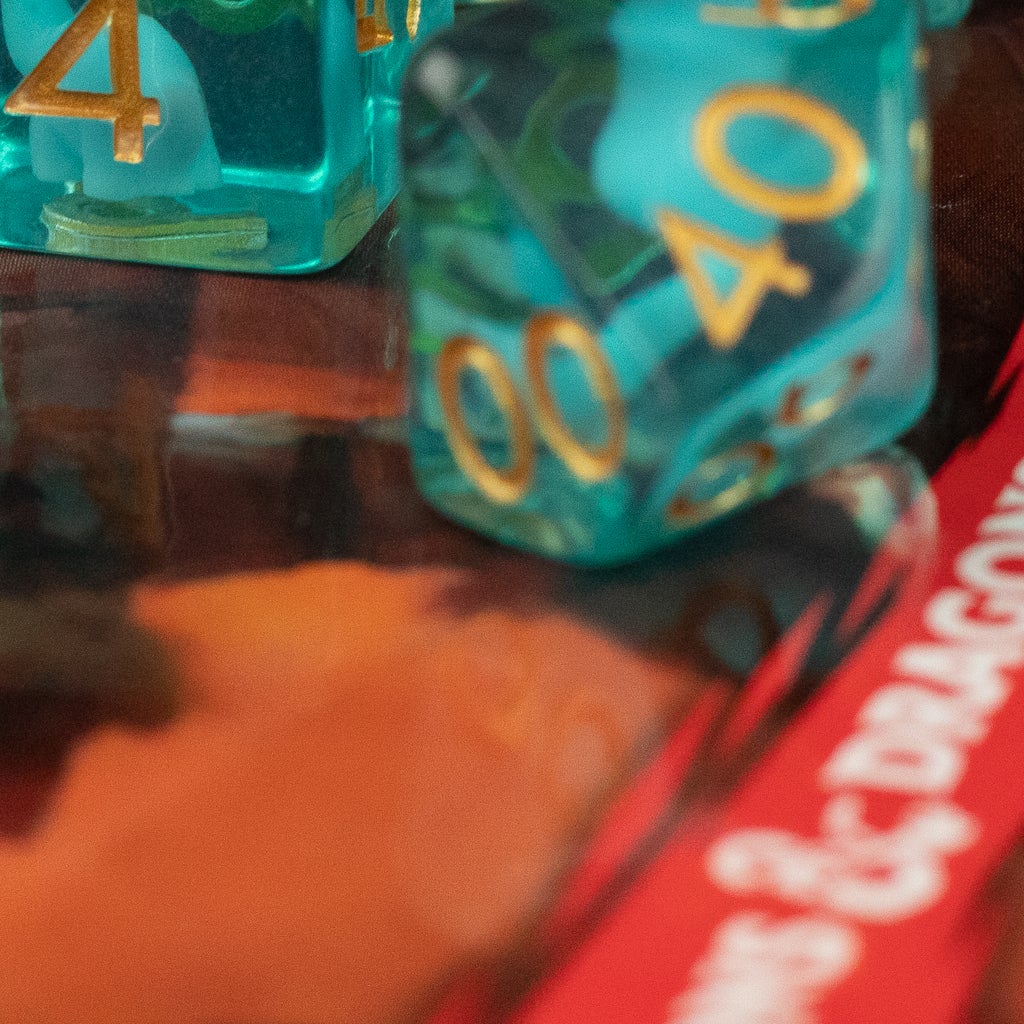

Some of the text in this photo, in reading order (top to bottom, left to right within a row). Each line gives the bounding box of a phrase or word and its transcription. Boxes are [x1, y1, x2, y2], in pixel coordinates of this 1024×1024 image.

[654, 82, 871, 351] 40
[436, 310, 627, 505] 00
[814, 456, 1024, 798] DRAGO
[704, 791, 981, 924] &
